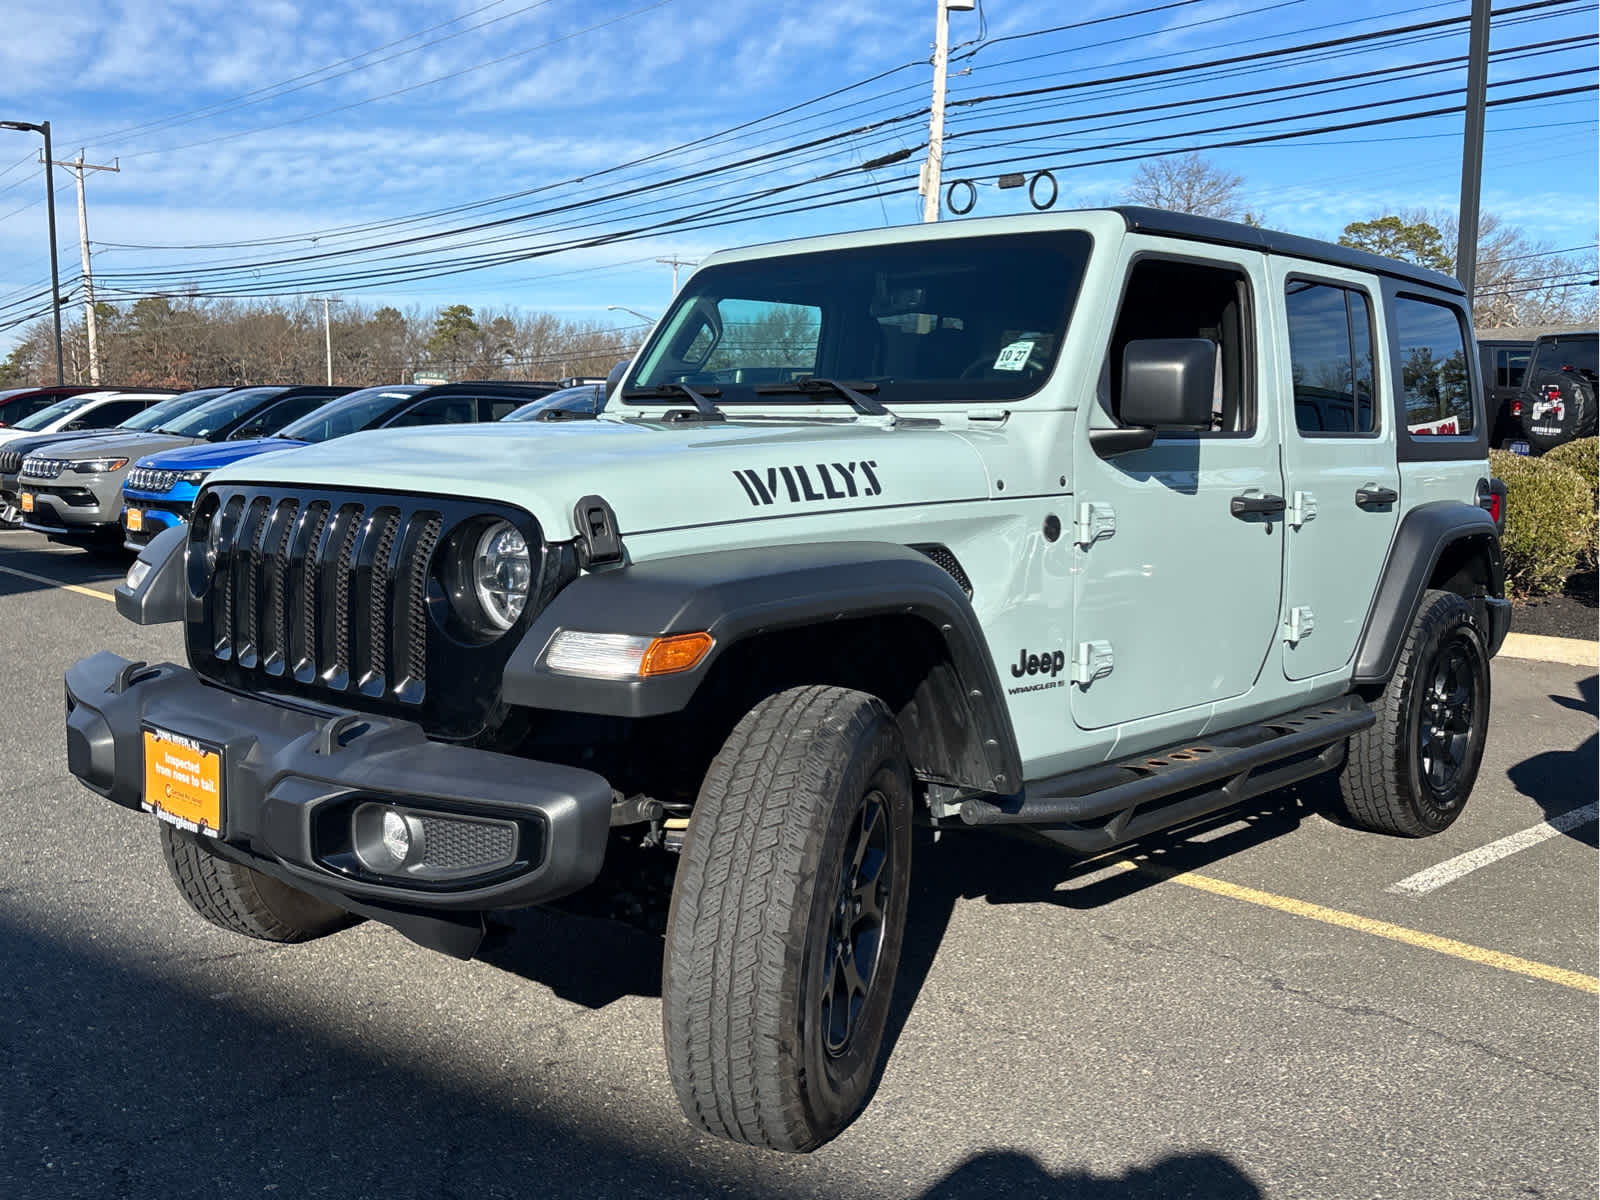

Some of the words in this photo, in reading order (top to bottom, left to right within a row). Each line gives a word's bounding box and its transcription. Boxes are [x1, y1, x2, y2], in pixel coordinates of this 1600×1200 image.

[732, 460, 882, 506] WILLYS
[1011, 648, 1065, 678] Jeep
[1008, 681, 1057, 695] WRANGLER
[155, 762, 172, 778] from
[172, 769, 190, 784] nose
[191, 773, 200, 787] to
[164, 752, 200, 774] Inspected
